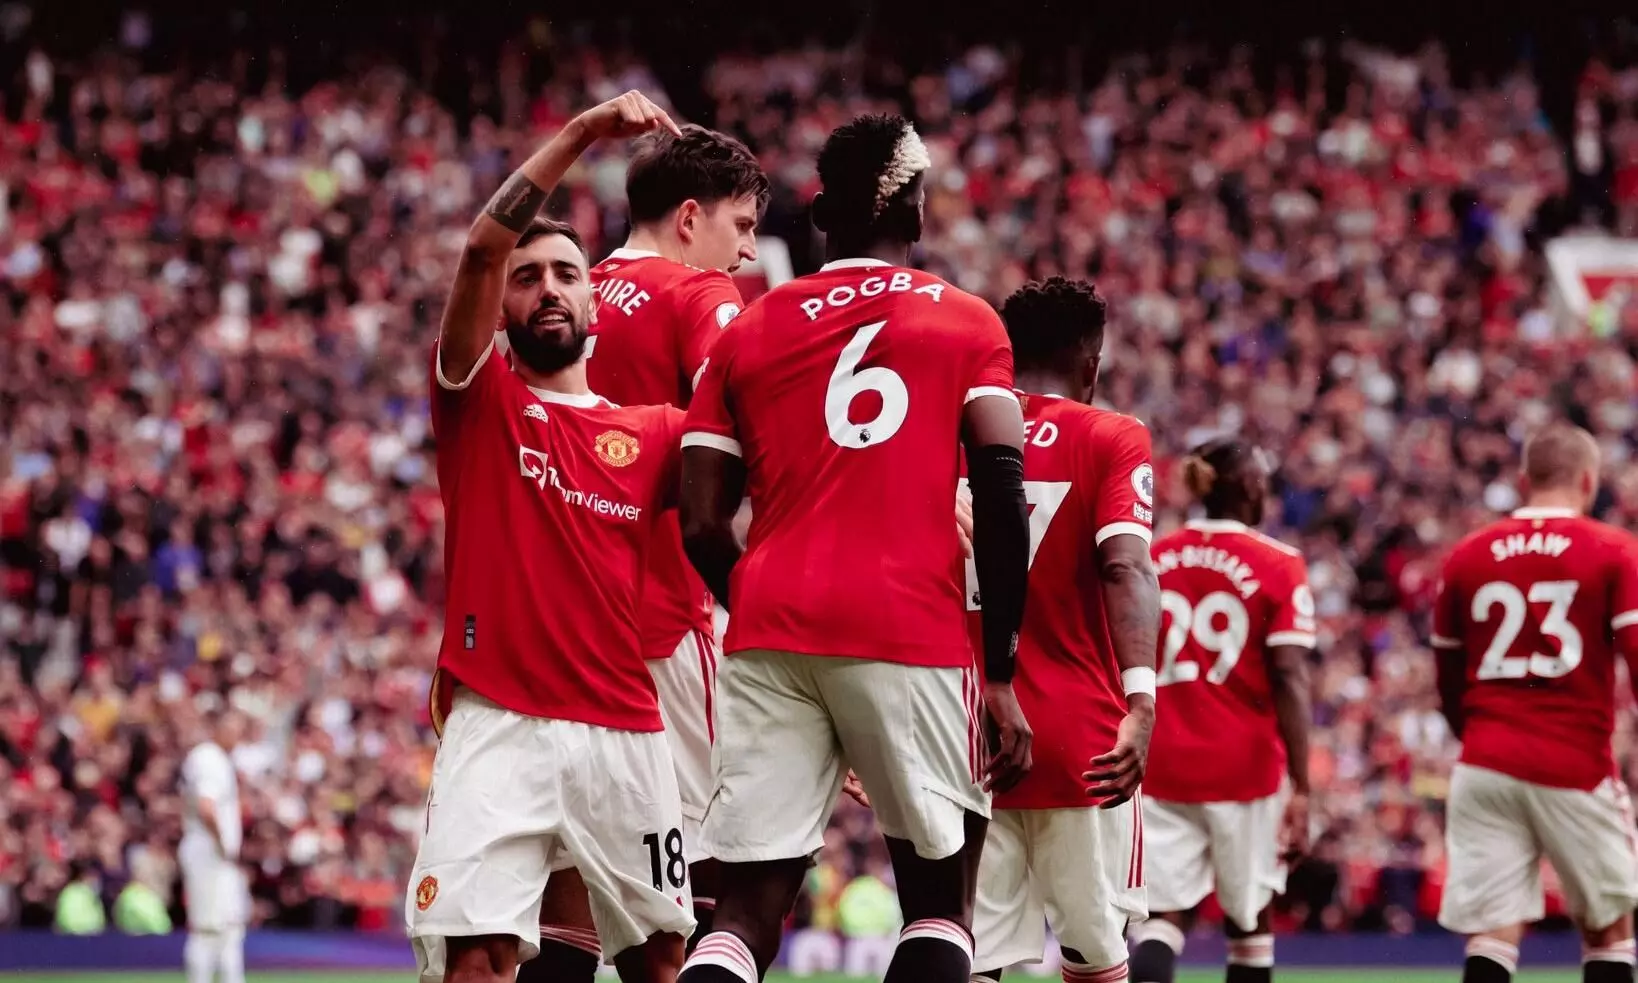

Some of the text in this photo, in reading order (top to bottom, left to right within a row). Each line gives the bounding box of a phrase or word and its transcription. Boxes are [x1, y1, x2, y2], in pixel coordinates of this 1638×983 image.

[591, 278, 651, 316] UIRE
[800, 272, 945, 321] POGBA
[824, 320, 909, 449] 6
[548, 466, 641, 521] TmViewer
[1490, 532, 1572, 562] SHAW
[1157, 589, 1250, 686] 29
[1471, 580, 1584, 681] 23
[642, 827, 686, 893] 18
